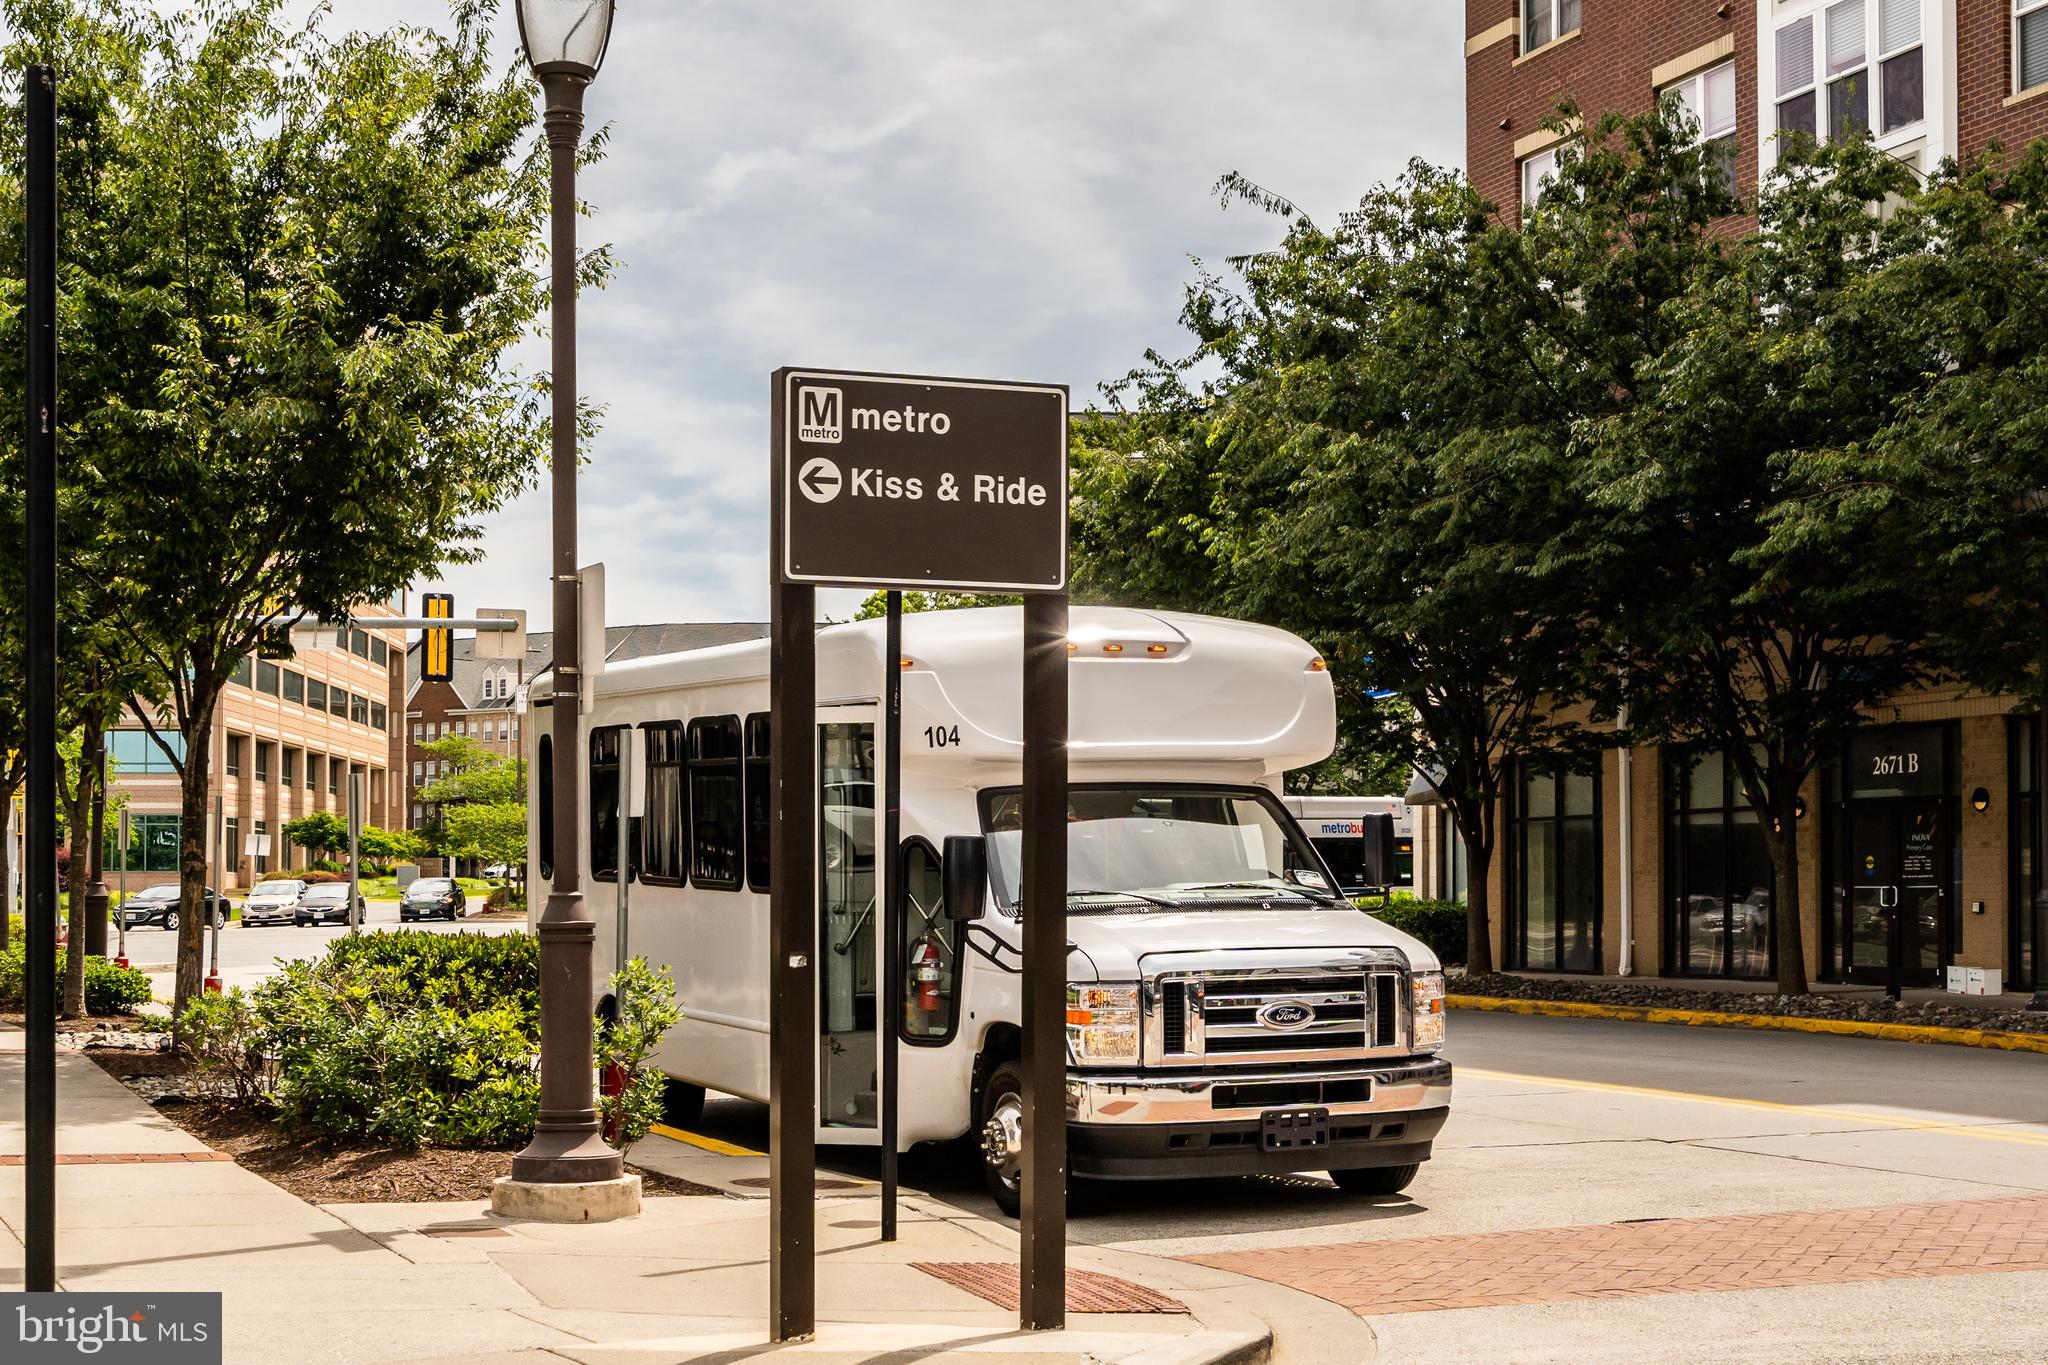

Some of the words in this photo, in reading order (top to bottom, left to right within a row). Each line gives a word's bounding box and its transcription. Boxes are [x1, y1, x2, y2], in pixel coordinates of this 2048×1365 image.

[804, 391, 838, 427] M
[851, 405, 951, 435] metro
[801, 427, 840, 440] metro
[851, 467, 923, 500] Kiss
[936, 472, 960, 502] &
[974, 474, 1047, 506] Ride
[924, 725, 961, 748] 104
[1872, 755, 1904, 775] 2671
[1907, 753, 1919, 773] B
[1321, 822, 1364, 834] metrobu
[1276, 1008, 1302, 1021] Ford
